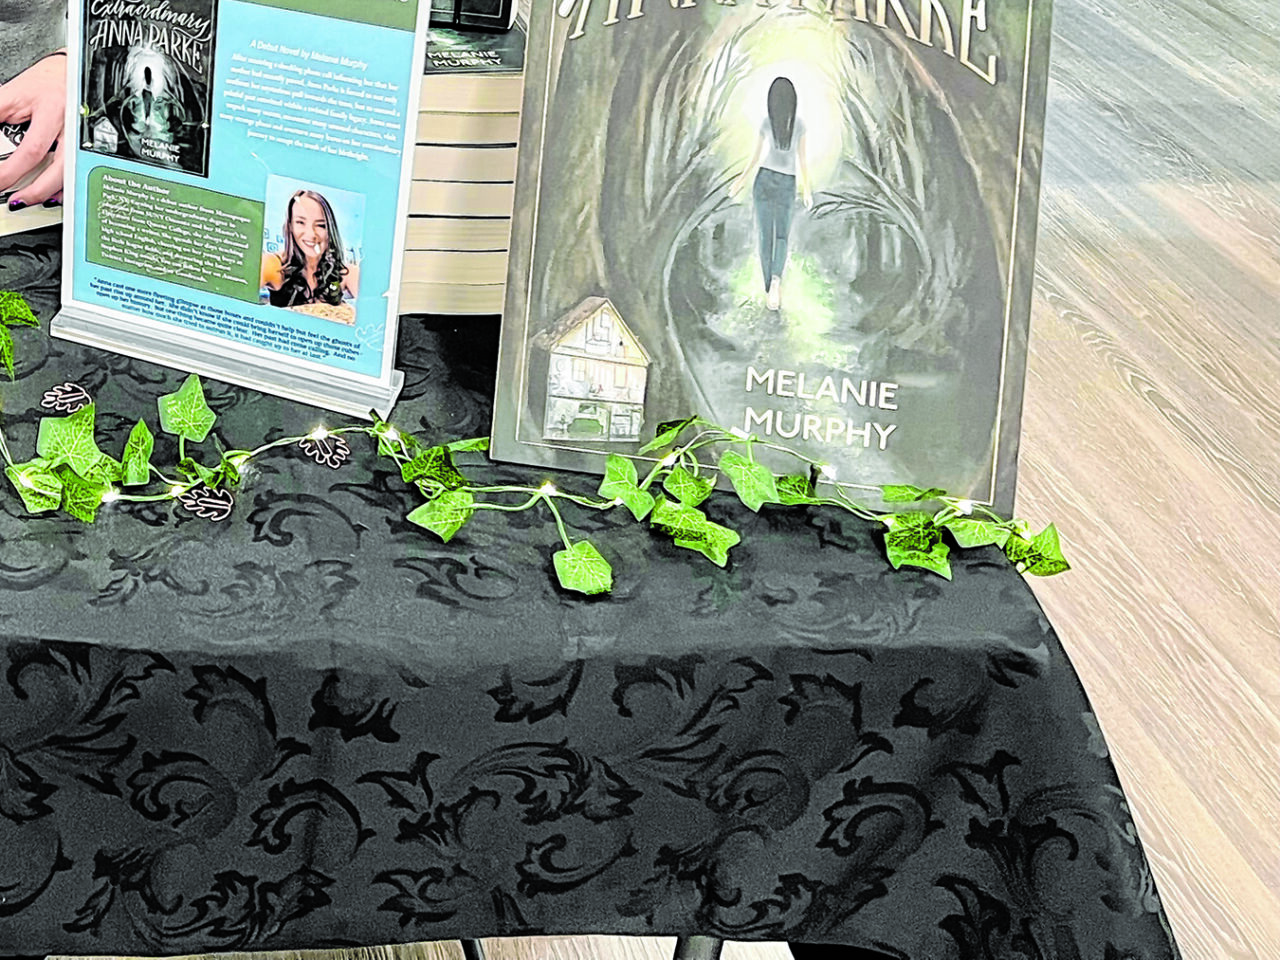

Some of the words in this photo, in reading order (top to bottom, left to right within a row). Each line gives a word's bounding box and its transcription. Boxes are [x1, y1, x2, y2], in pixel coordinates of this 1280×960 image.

[90, 20, 144, 50] ANNA
[148, 23, 204, 74] PARKE
[428, 51, 499, 59] MELANIE
[433, 58, 502, 67] MURPHY
[141, 138, 180, 154] MELANIE
[141, 147, 180, 163] MURPHY
[746, 365, 900, 411] MELANIE
[744, 405, 898, 451] MURPHY
